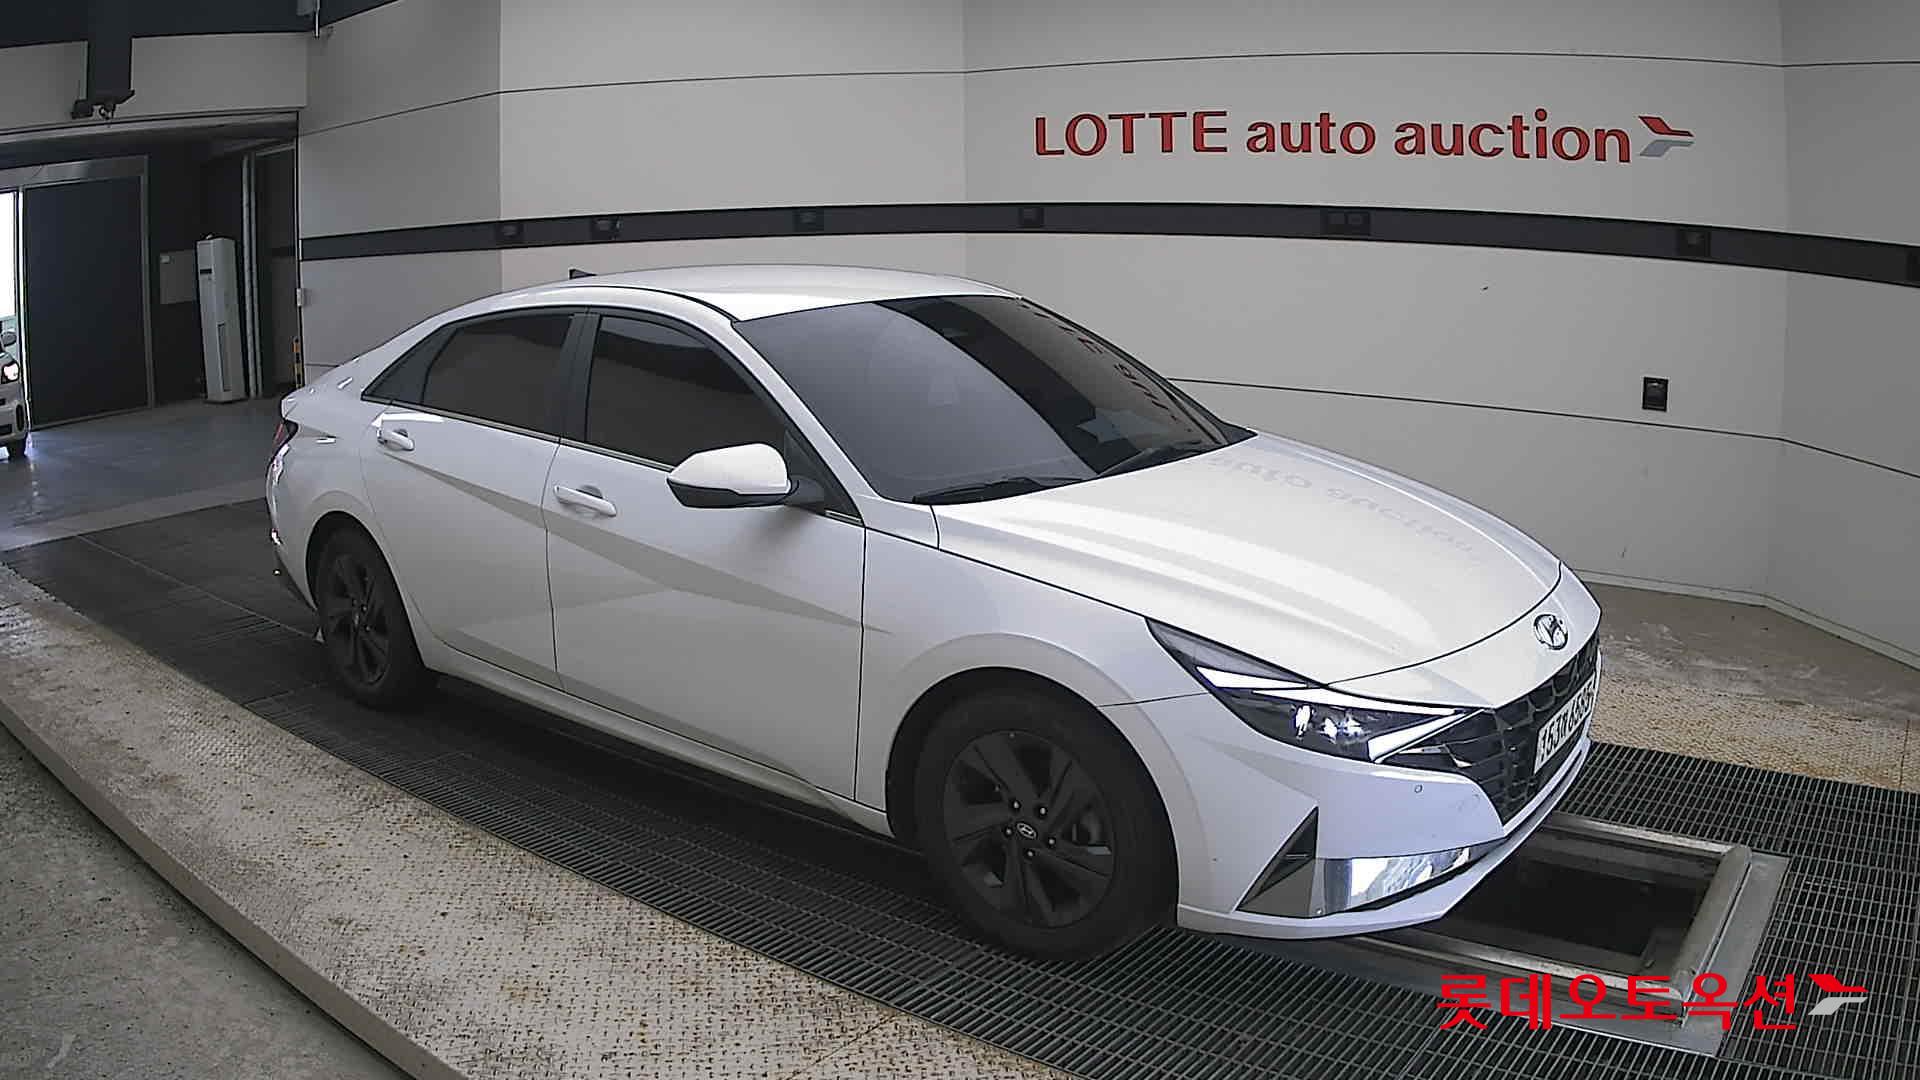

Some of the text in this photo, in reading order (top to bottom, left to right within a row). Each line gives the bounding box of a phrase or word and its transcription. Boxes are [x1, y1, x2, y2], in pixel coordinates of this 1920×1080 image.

[1035, 108, 1631, 163] LOTTE auto auction
